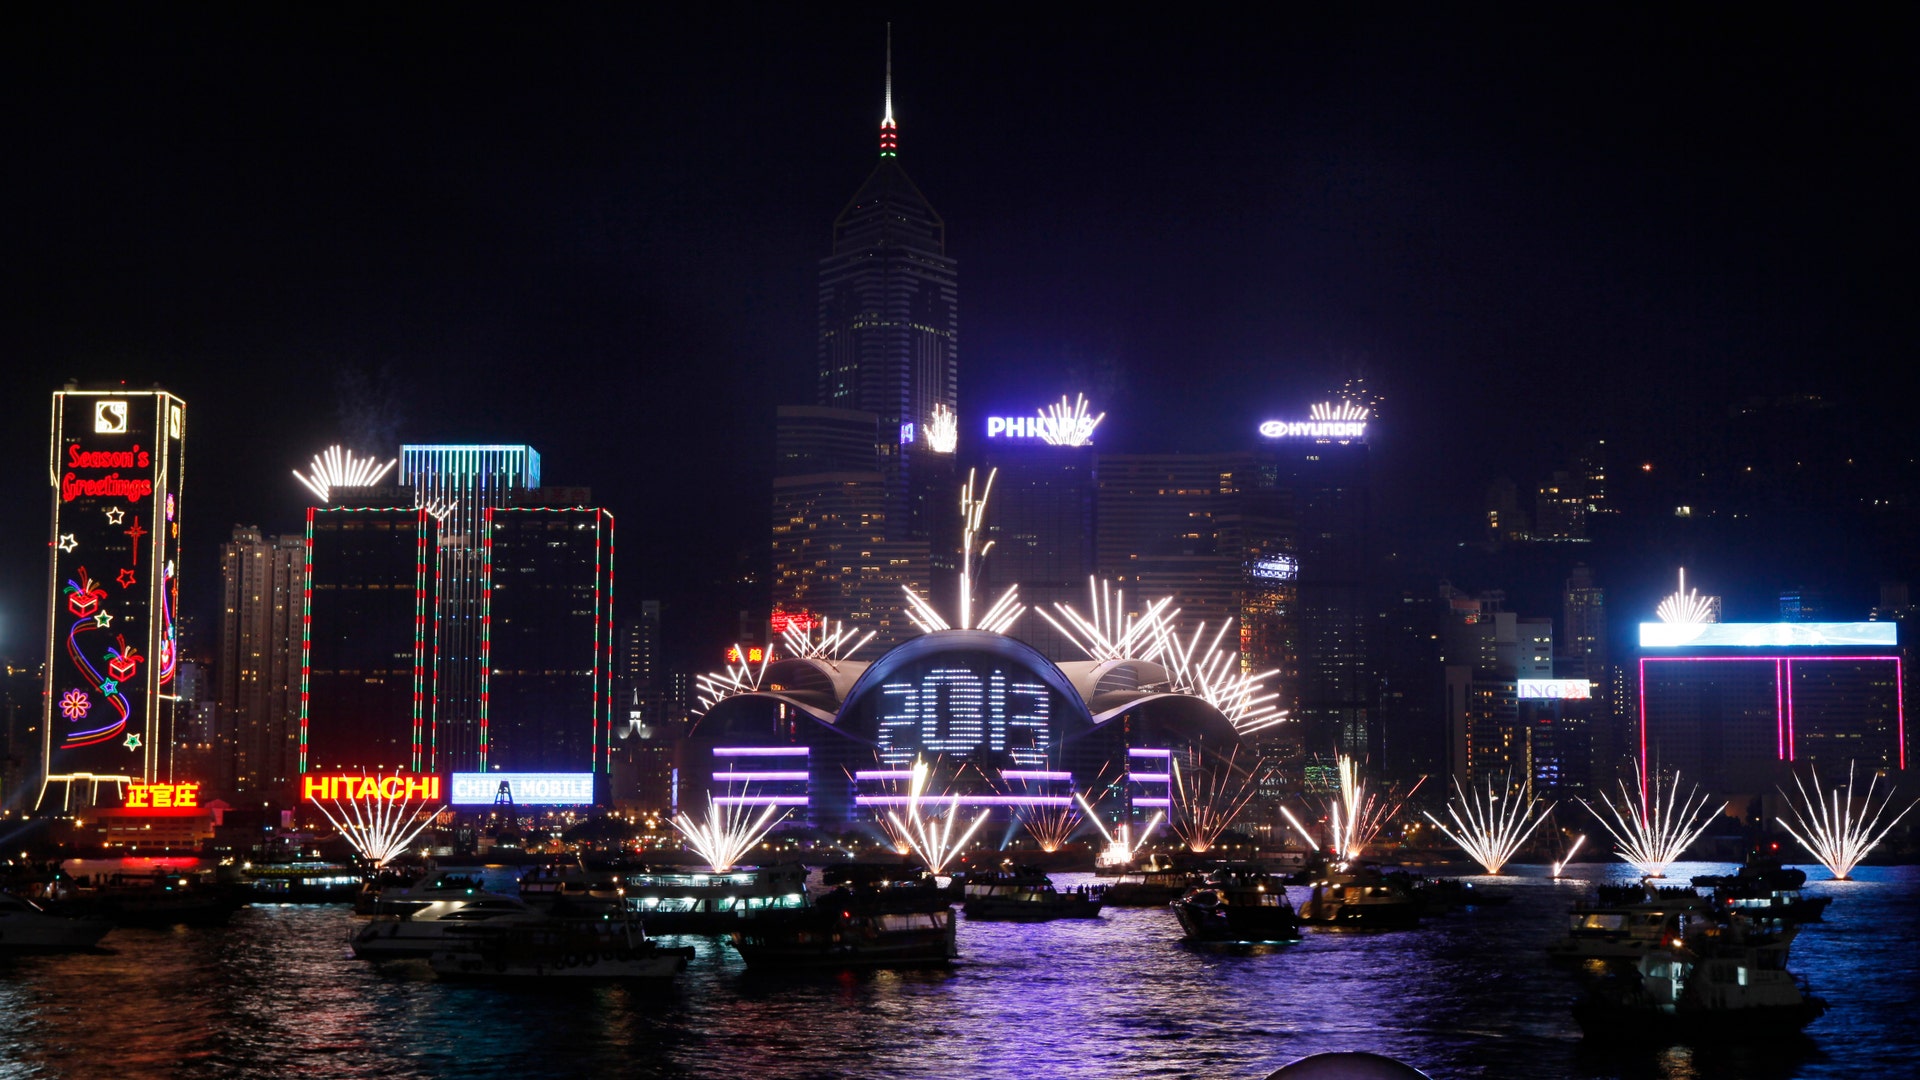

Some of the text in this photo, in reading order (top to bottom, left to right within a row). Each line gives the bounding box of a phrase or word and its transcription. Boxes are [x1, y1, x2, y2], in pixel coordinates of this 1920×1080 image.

[1288, 422, 1365, 436] HYUNDAI
[68, 444, 149, 468] Season's
[63, 472, 152, 502] Greetings
[333, 486, 414, 498] OLYMPUS
[1520, 684, 1558, 699] ING
[879, 670, 1049, 763] 2013
[126, 783, 198, 807] 正官庄
[304, 776, 439, 799] HITACHI
[520, 780, 591, 797] MOBILE
